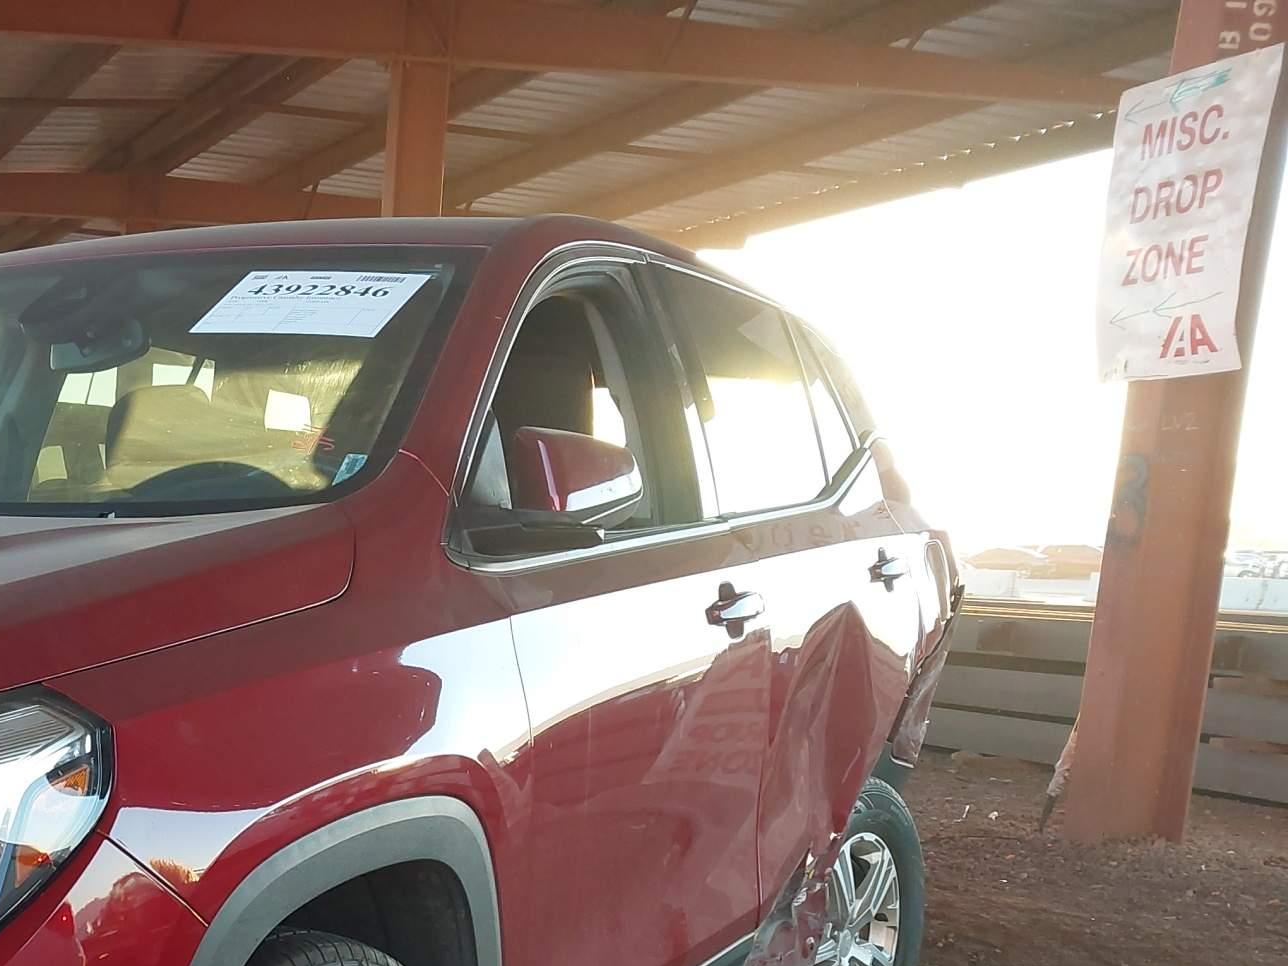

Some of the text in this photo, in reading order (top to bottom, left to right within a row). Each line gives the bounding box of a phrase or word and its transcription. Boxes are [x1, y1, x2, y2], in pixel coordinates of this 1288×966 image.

[1140, 104, 1230, 161] MISC.
[1129, 168, 1224, 224] DROP
[1121, 234, 1209, 287] ZONE
[247, 283, 392, 299] 43922846
